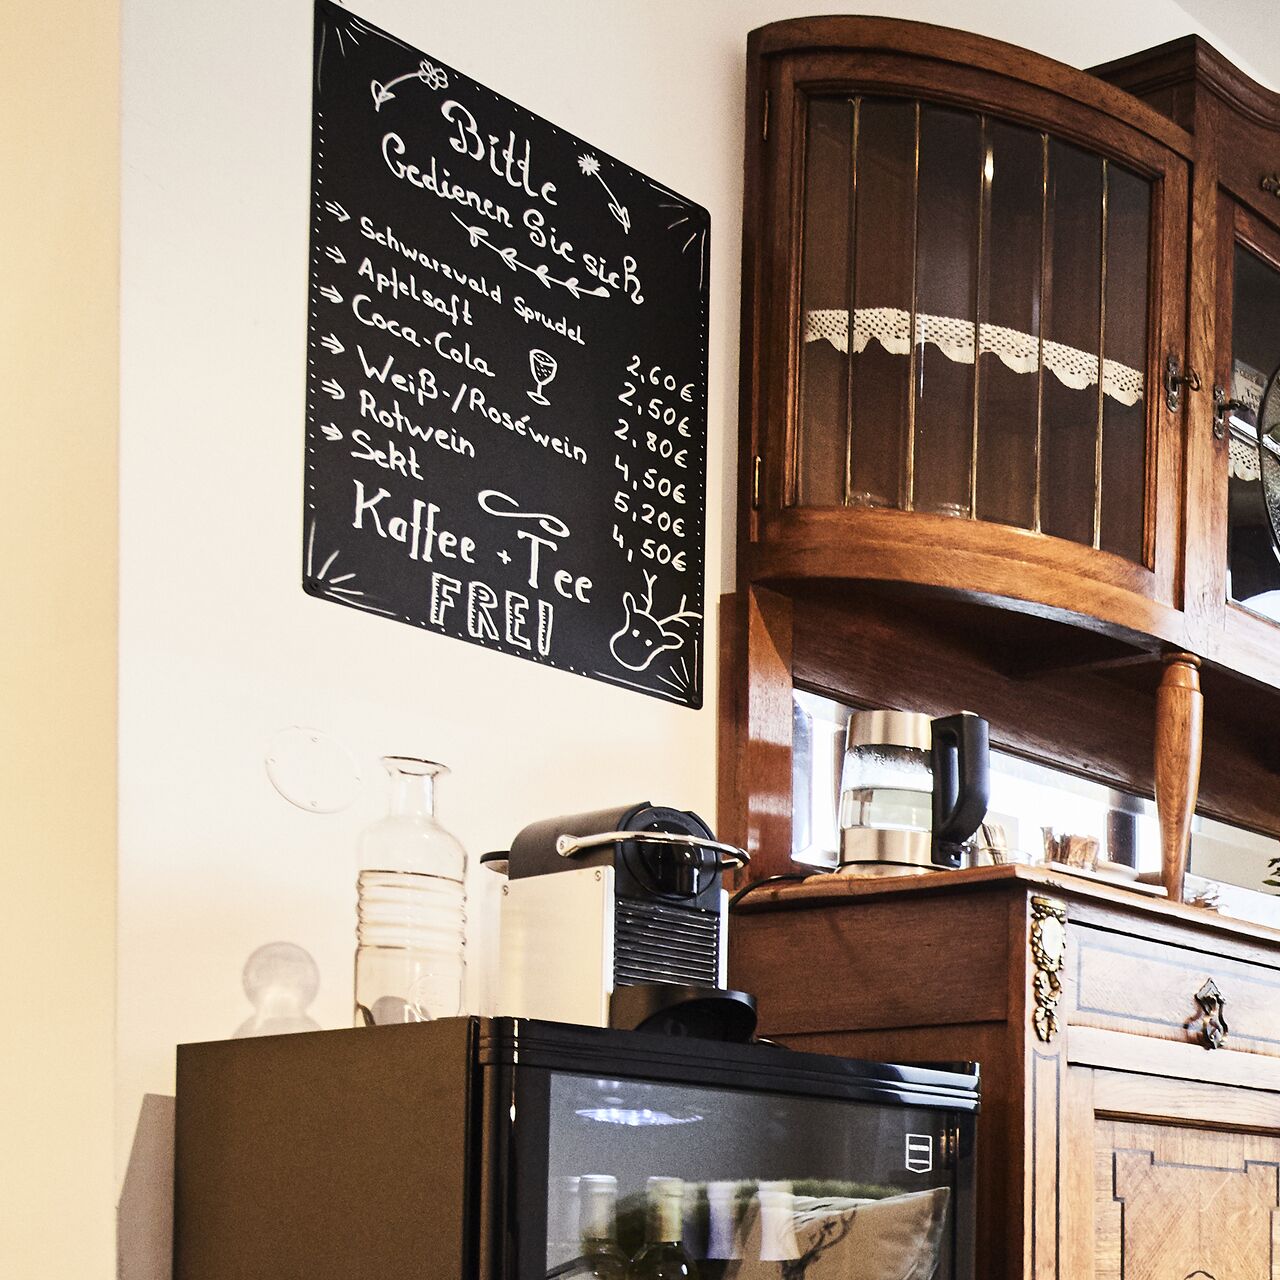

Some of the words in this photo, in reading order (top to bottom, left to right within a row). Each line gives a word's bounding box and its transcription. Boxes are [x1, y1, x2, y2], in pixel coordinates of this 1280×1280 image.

[361, 217, 501, 304] Schwarzwald
[514, 296, 586, 345] Sprudel
[523, 209, 575, 263] Sie
[583, 254, 645, 304] sich
[352, 294, 496, 376] Coca-Cola
[627, 355, 695, 403] 2,60€
[360, 389, 475, 458] Rotwein
[618, 382, 692, 437] 2,50€
[351, 429, 424, 480] Sekt
[614, 419, 688, 469] 2,80€
[615, 455, 687, 504] 4,50€
[352, 479, 476, 564] Kaffee
[517, 530, 593, 604] Tee
[615, 491, 686, 538] 5,20€
[613, 524, 687, 571] 4,50€
[430, 572, 558, 657] FREI
